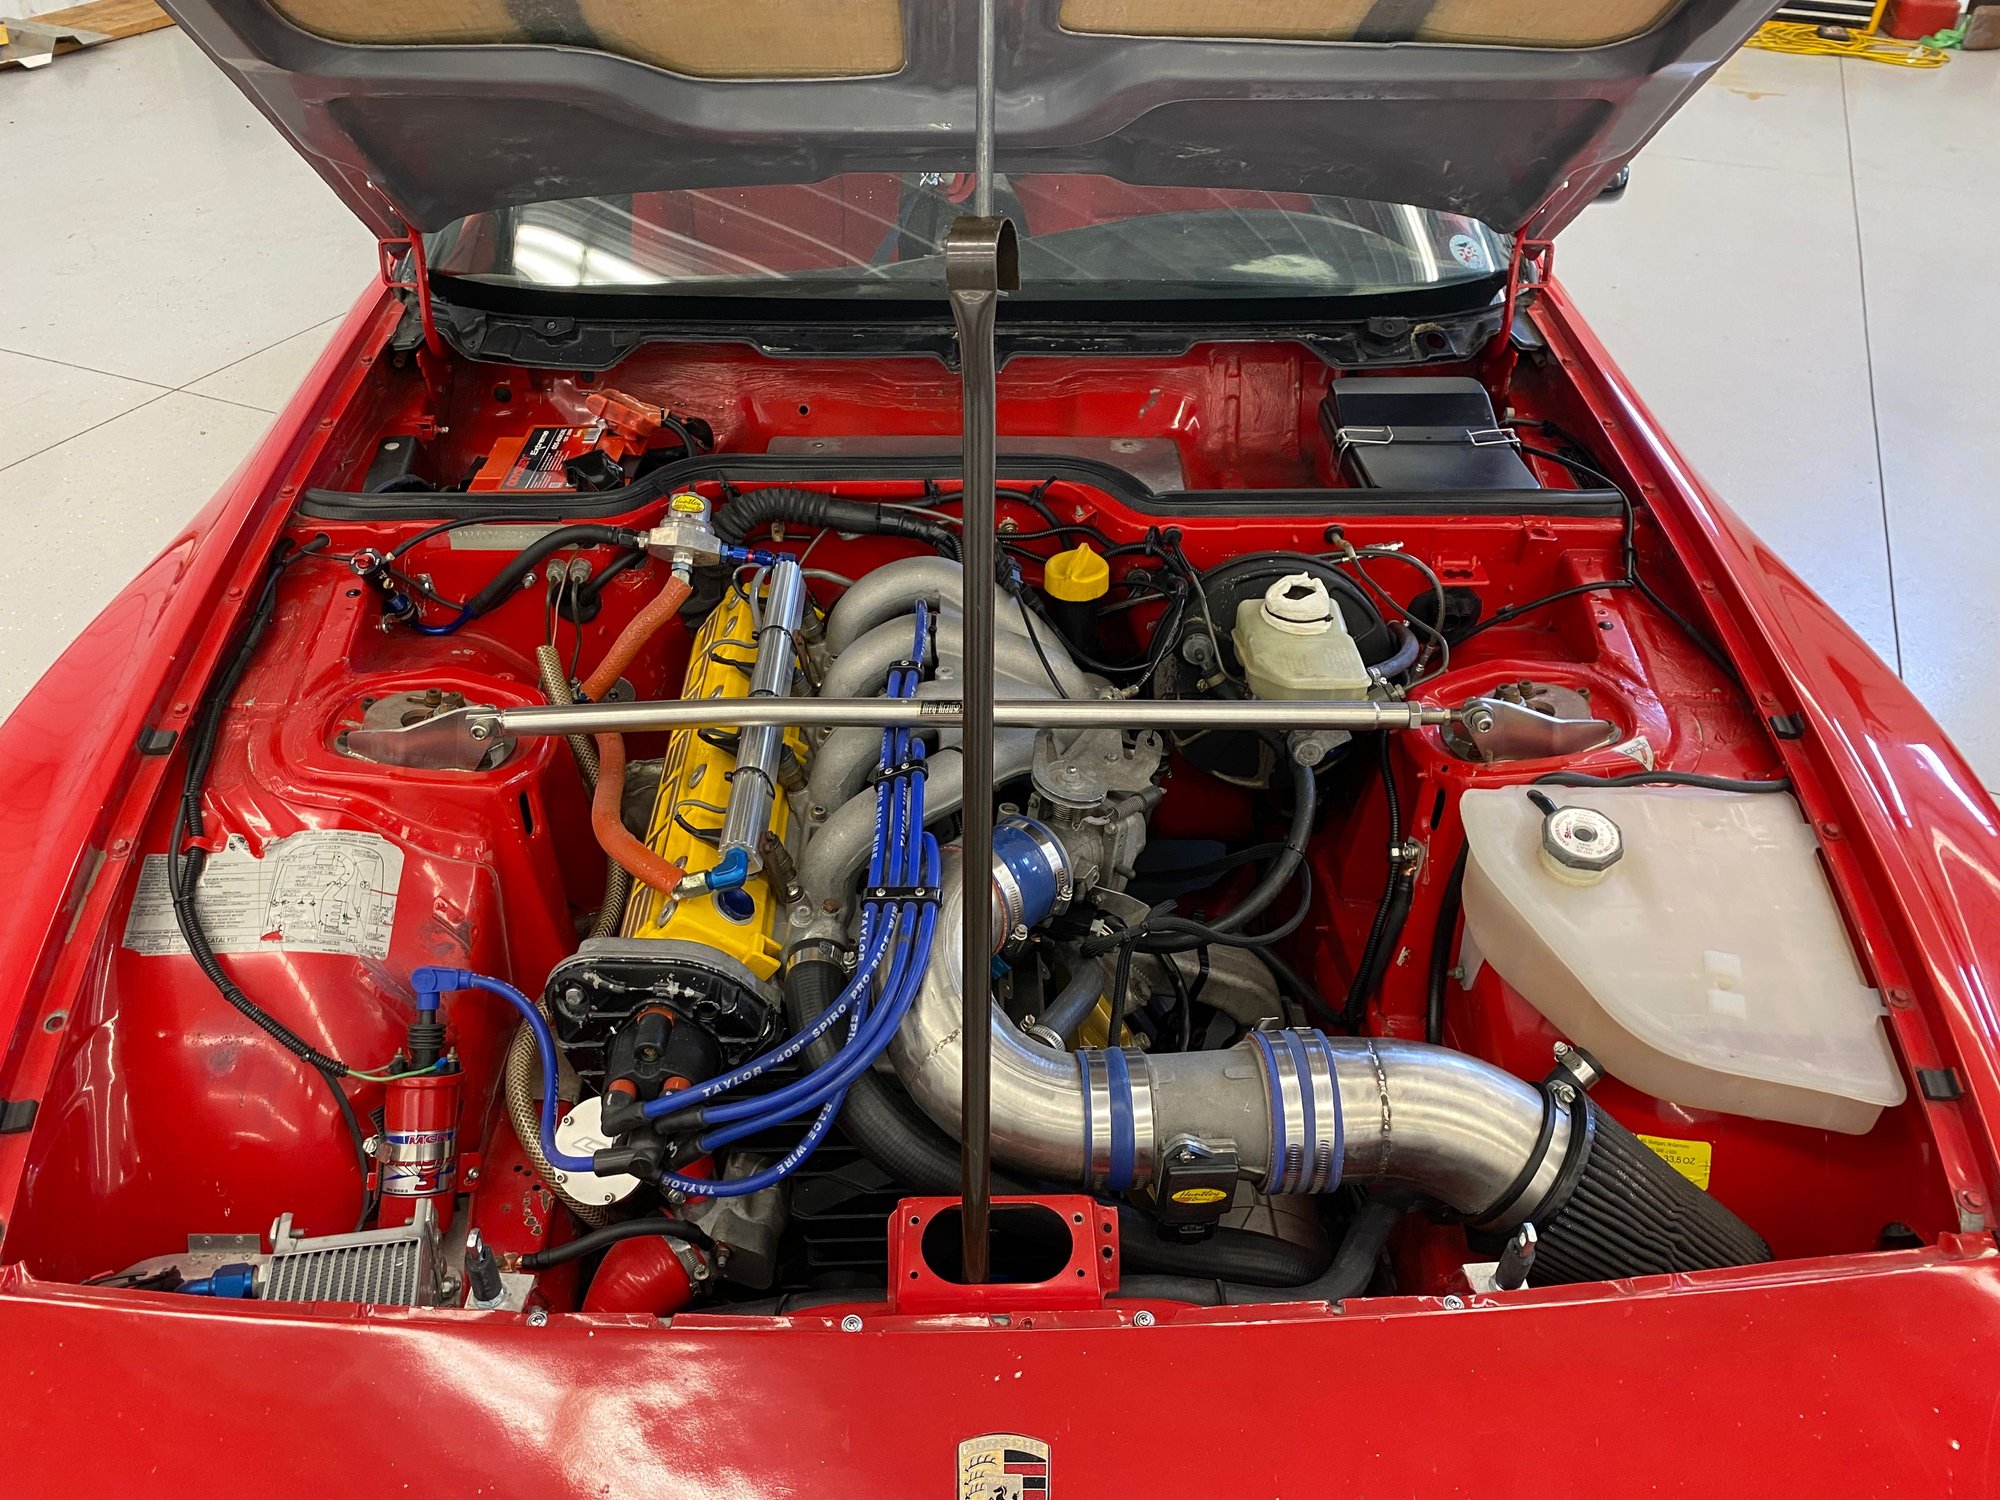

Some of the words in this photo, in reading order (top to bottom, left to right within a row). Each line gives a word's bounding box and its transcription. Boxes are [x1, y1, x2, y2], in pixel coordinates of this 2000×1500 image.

[859, 911, 870, 961] TAYLOR
[702, 1065, 763, 1098] TAYLOR
[811, 1003, 847, 1039] SPIRO
[850, 974, 870, 1001] PRO
[871, 935, 889, 969] RACE
[888, 905, 898, 930] WIR
[846, 1014, 859, 1046] SPI
[807, 1101, 833, 1141] RACE
[776, 1144, 808, 1175] WIRE
[1683, 1157, 1696, 1165] OZ
[662, 1176, 715, 1195] TAYLOR
